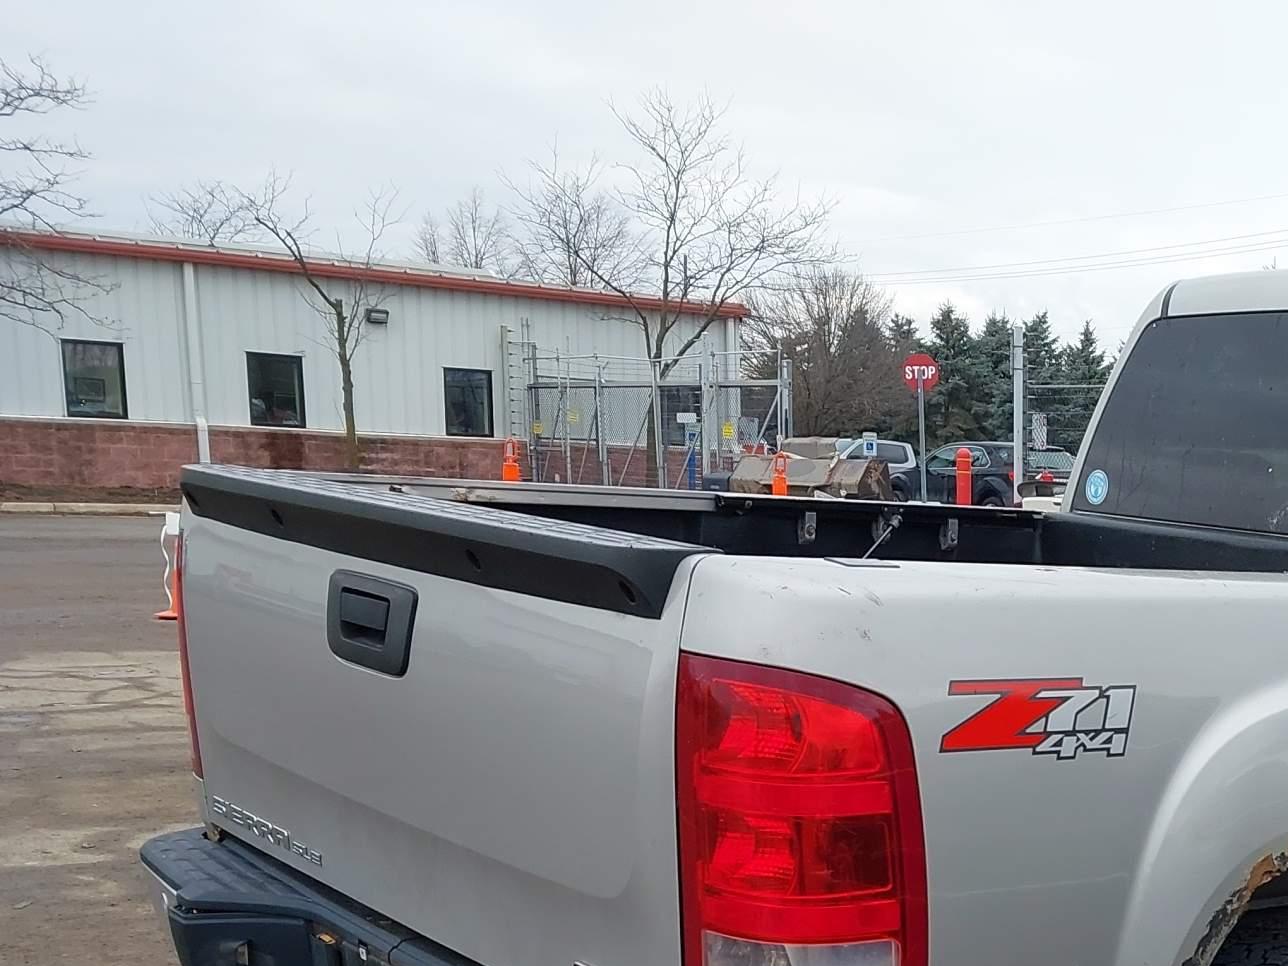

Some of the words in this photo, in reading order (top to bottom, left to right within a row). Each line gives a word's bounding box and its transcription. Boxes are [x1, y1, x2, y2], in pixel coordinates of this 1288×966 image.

[904, 365, 936, 380] STOP
[939, 677, 1136, 753] Z71
[212, 794, 291, 850] SIERRA
